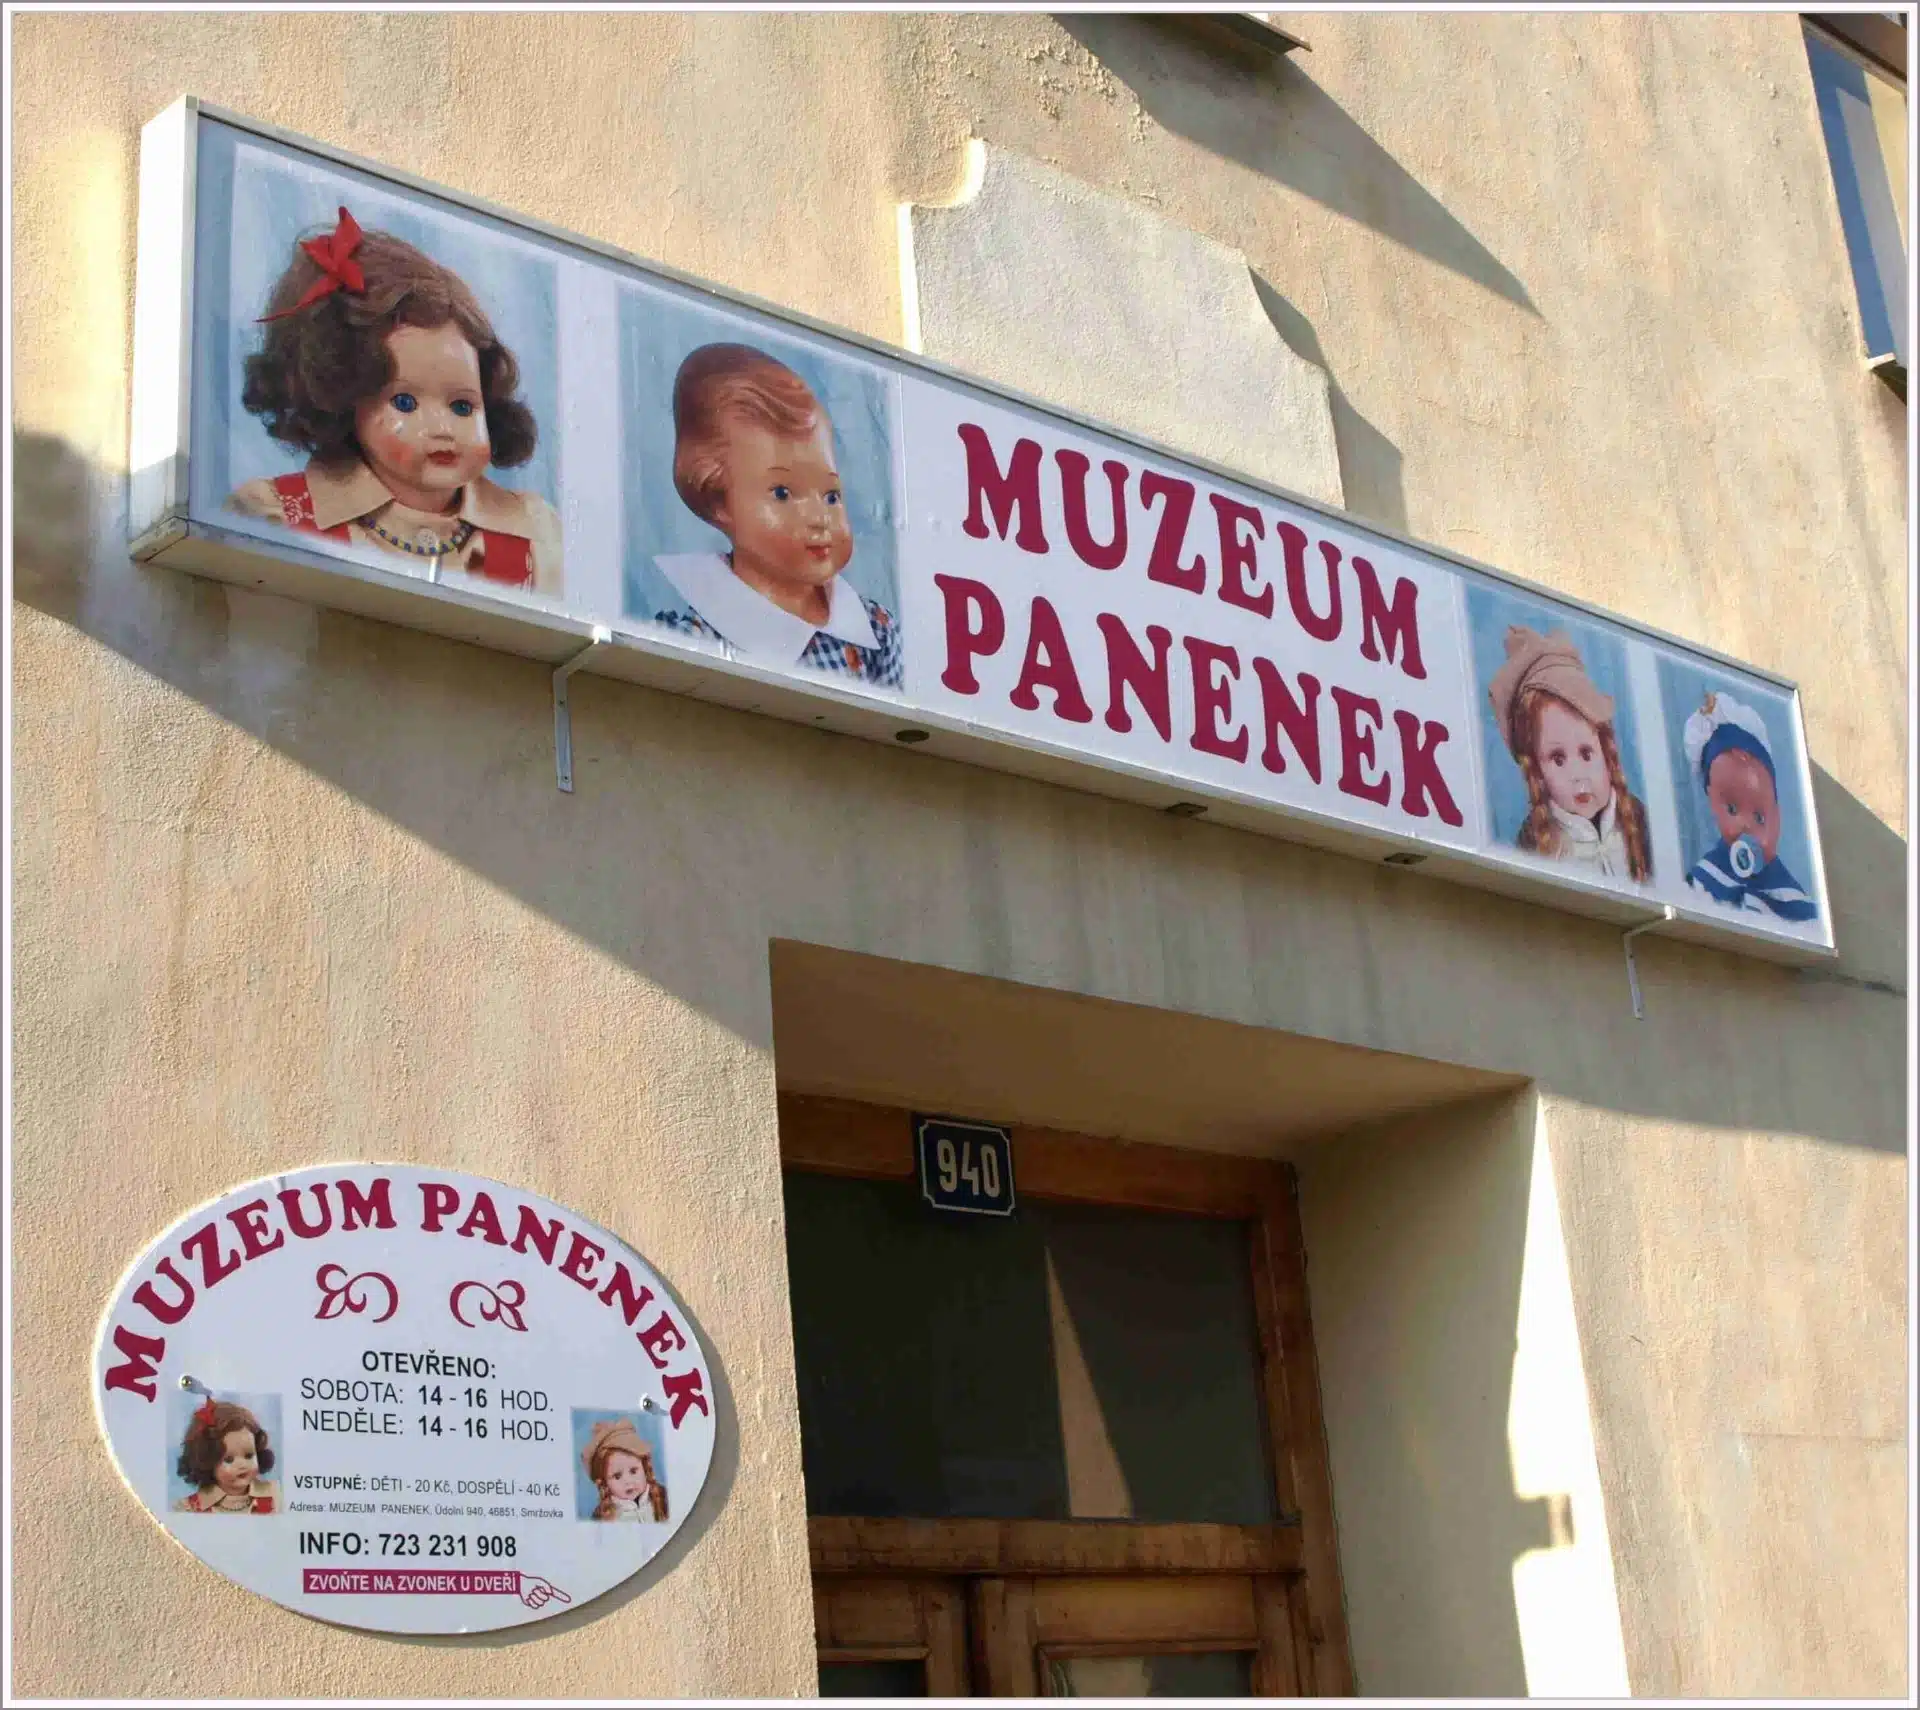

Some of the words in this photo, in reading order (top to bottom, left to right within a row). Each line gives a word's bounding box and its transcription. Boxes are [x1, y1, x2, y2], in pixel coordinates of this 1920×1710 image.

[957, 423, 1427, 679] MUZEUM
[934, 572, 1464, 827] PANENEK
[937, 1139, 1000, 1197] 940
[105, 1179, 397, 1402] MUZEUM
[418, 1182, 709, 1430] PANENEK
[362, 1349, 496, 1378] OTEVŘENO:
[300, 1378, 403, 1404] SOBOTA:
[418, 1385, 443, 1406] 14
[464, 1388, 488, 1408] 16
[501, 1389, 554, 1412] HOD.
[302, 1407, 403, 1434] NEDĚLE:
[418, 1415, 443, 1436] 14
[464, 1418, 488, 1438] 16
[501, 1419, 554, 1442] HOD.
[294, 1474, 366, 1490] VSTUPNÉ:
[371, 1475, 402, 1491] DĚTI
[415, 1479, 430, 1492] 20
[434, 1479, 453, 1494] Kč,
[457, 1478, 515, 1495] DOSPĚLÍ
[526, 1483, 541, 1496] 40
[544, 1483, 560, 1496] Kč
[290, 1501, 325, 1512] Adresa:
[329, 1502, 376, 1513] MUZEUM
[381, 1503, 432, 1515] PANENEK,
[300, 1532, 369, 1555] INFO:
[378, 1534, 420, 1556] 723
[428, 1534, 467, 1556] 231
[477, 1536, 517, 1557] 908
[309, 1571, 368, 1591] ZVOŇTE
[374, 1576, 393, 1591] NA
[397, 1575, 457, 1592] ZVONEK
[460, 1576, 470, 1591] U
[474, 1573, 516, 1592] DVEŘÍ
